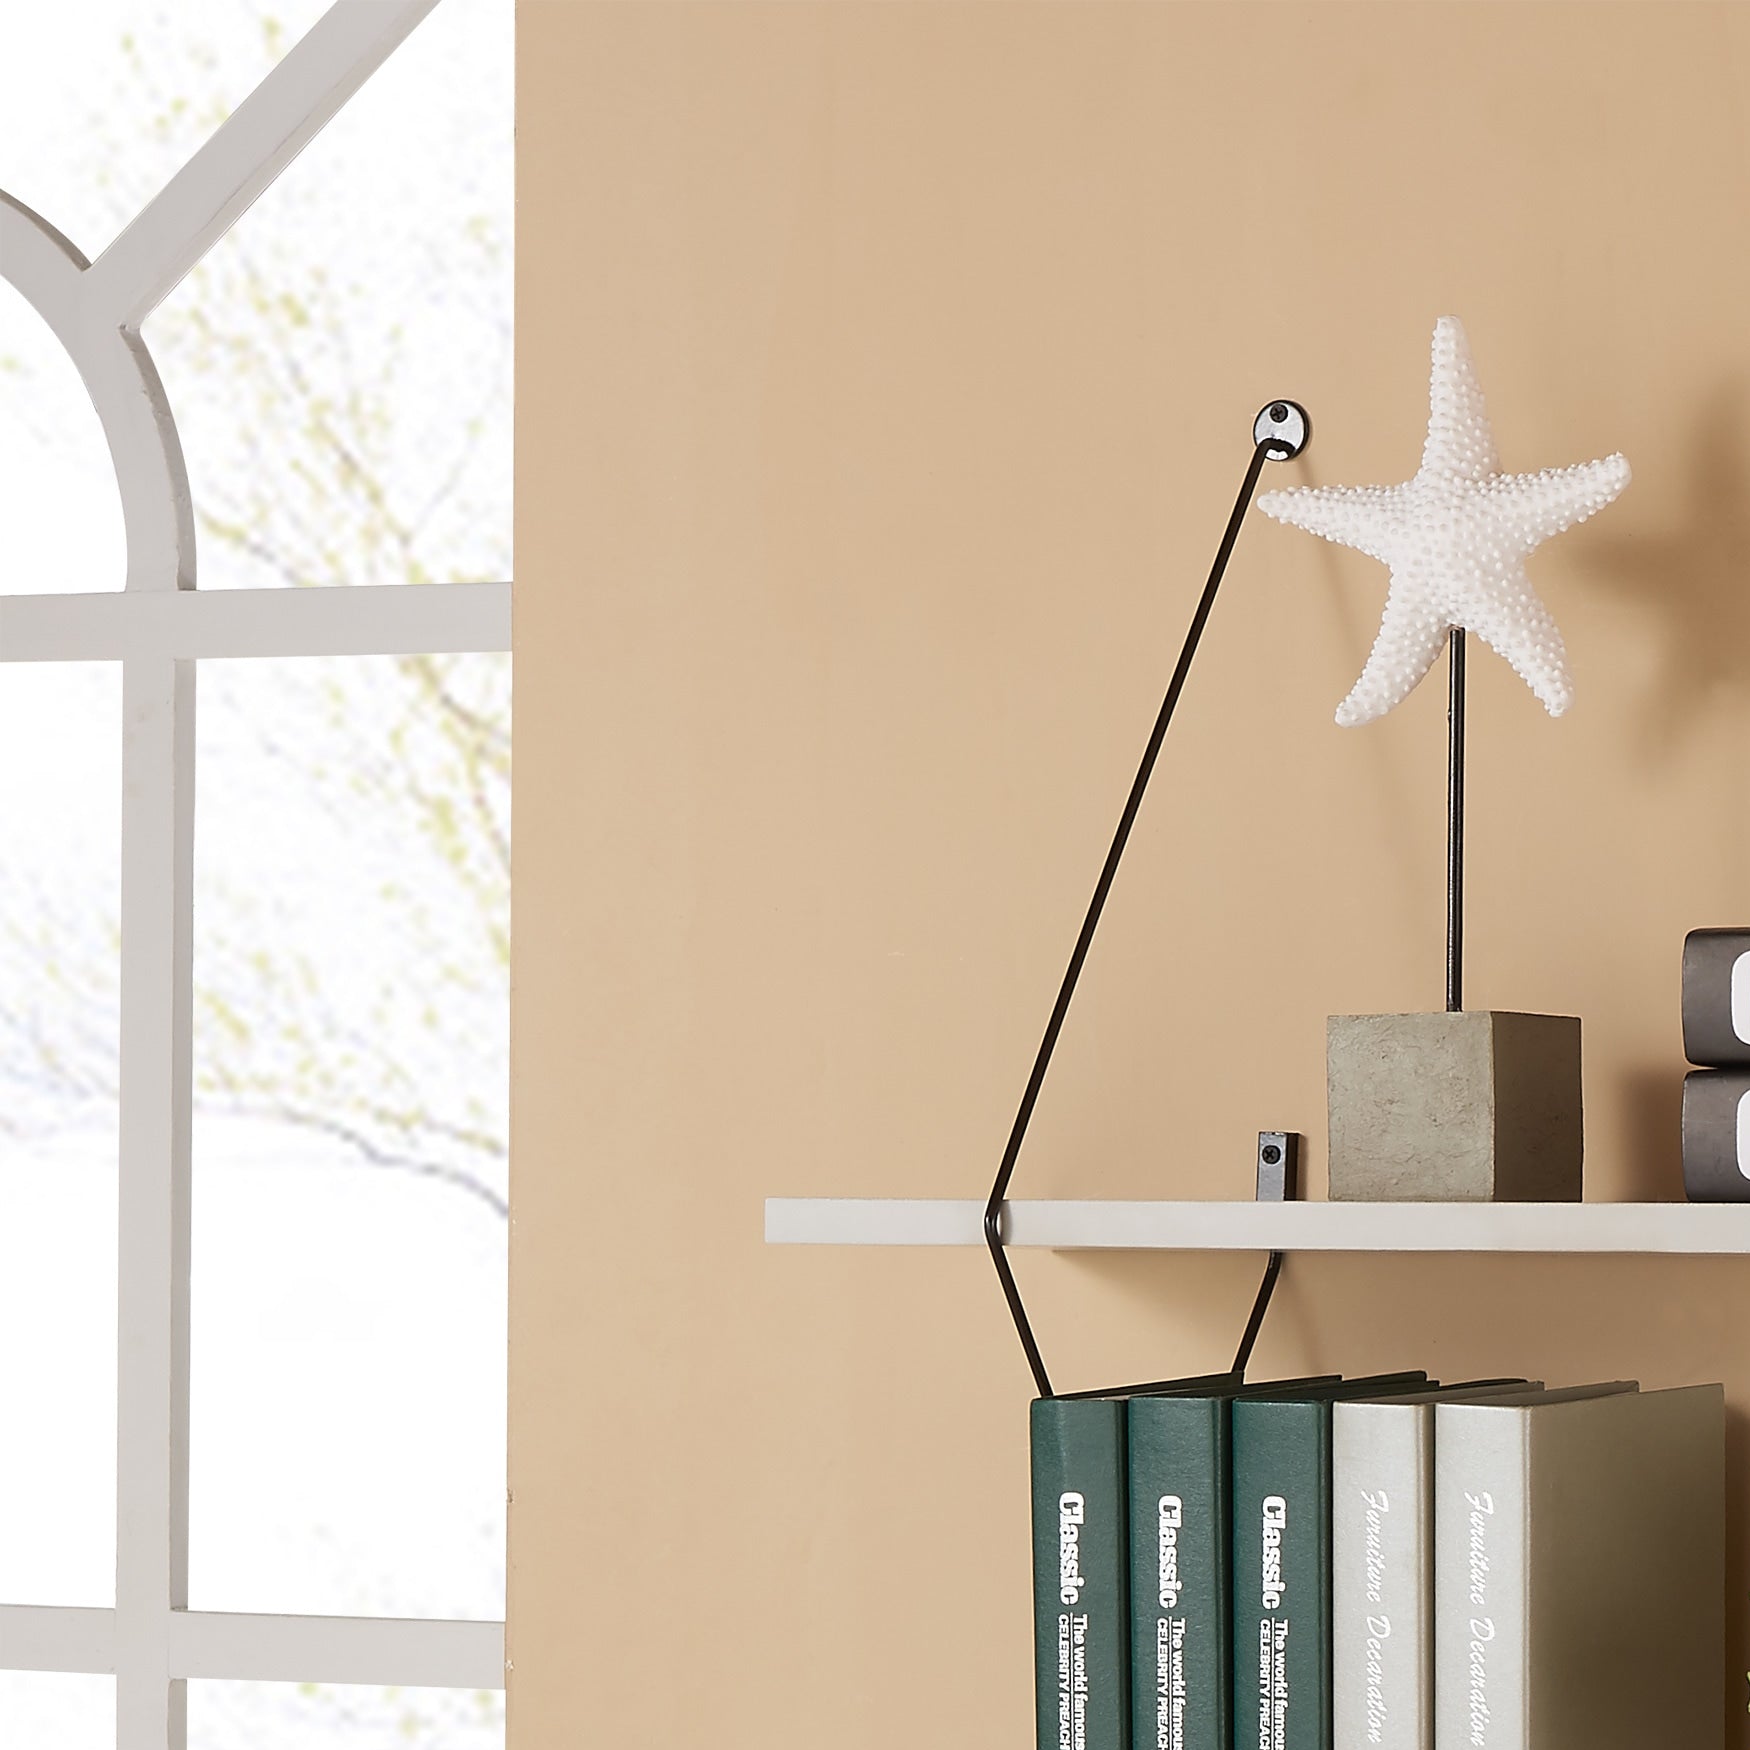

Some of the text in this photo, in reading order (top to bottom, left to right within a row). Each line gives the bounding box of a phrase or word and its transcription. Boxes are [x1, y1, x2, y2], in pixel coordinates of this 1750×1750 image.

[1059, 1491, 1085, 1605] Classic
[1158, 1495, 1183, 1609] Classic
[1262, 1495, 1287, 1610] Classic
[1073, 1613, 1088, 1644] The
[1157, 1617, 1169, 1696] CELEBRITY
[1172, 1617, 1187, 1649] The
[1259, 1619, 1271, 1698] CELEBRITY
[1274, 1618, 1289, 1651] The
[1058, 1614, 1070, 1750] CELEBRITY PREACH
[1073, 1646, 1088, 1692] world
[1172, 1650, 1187, 1697] world
[1274, 1652, 1289, 1698] world
